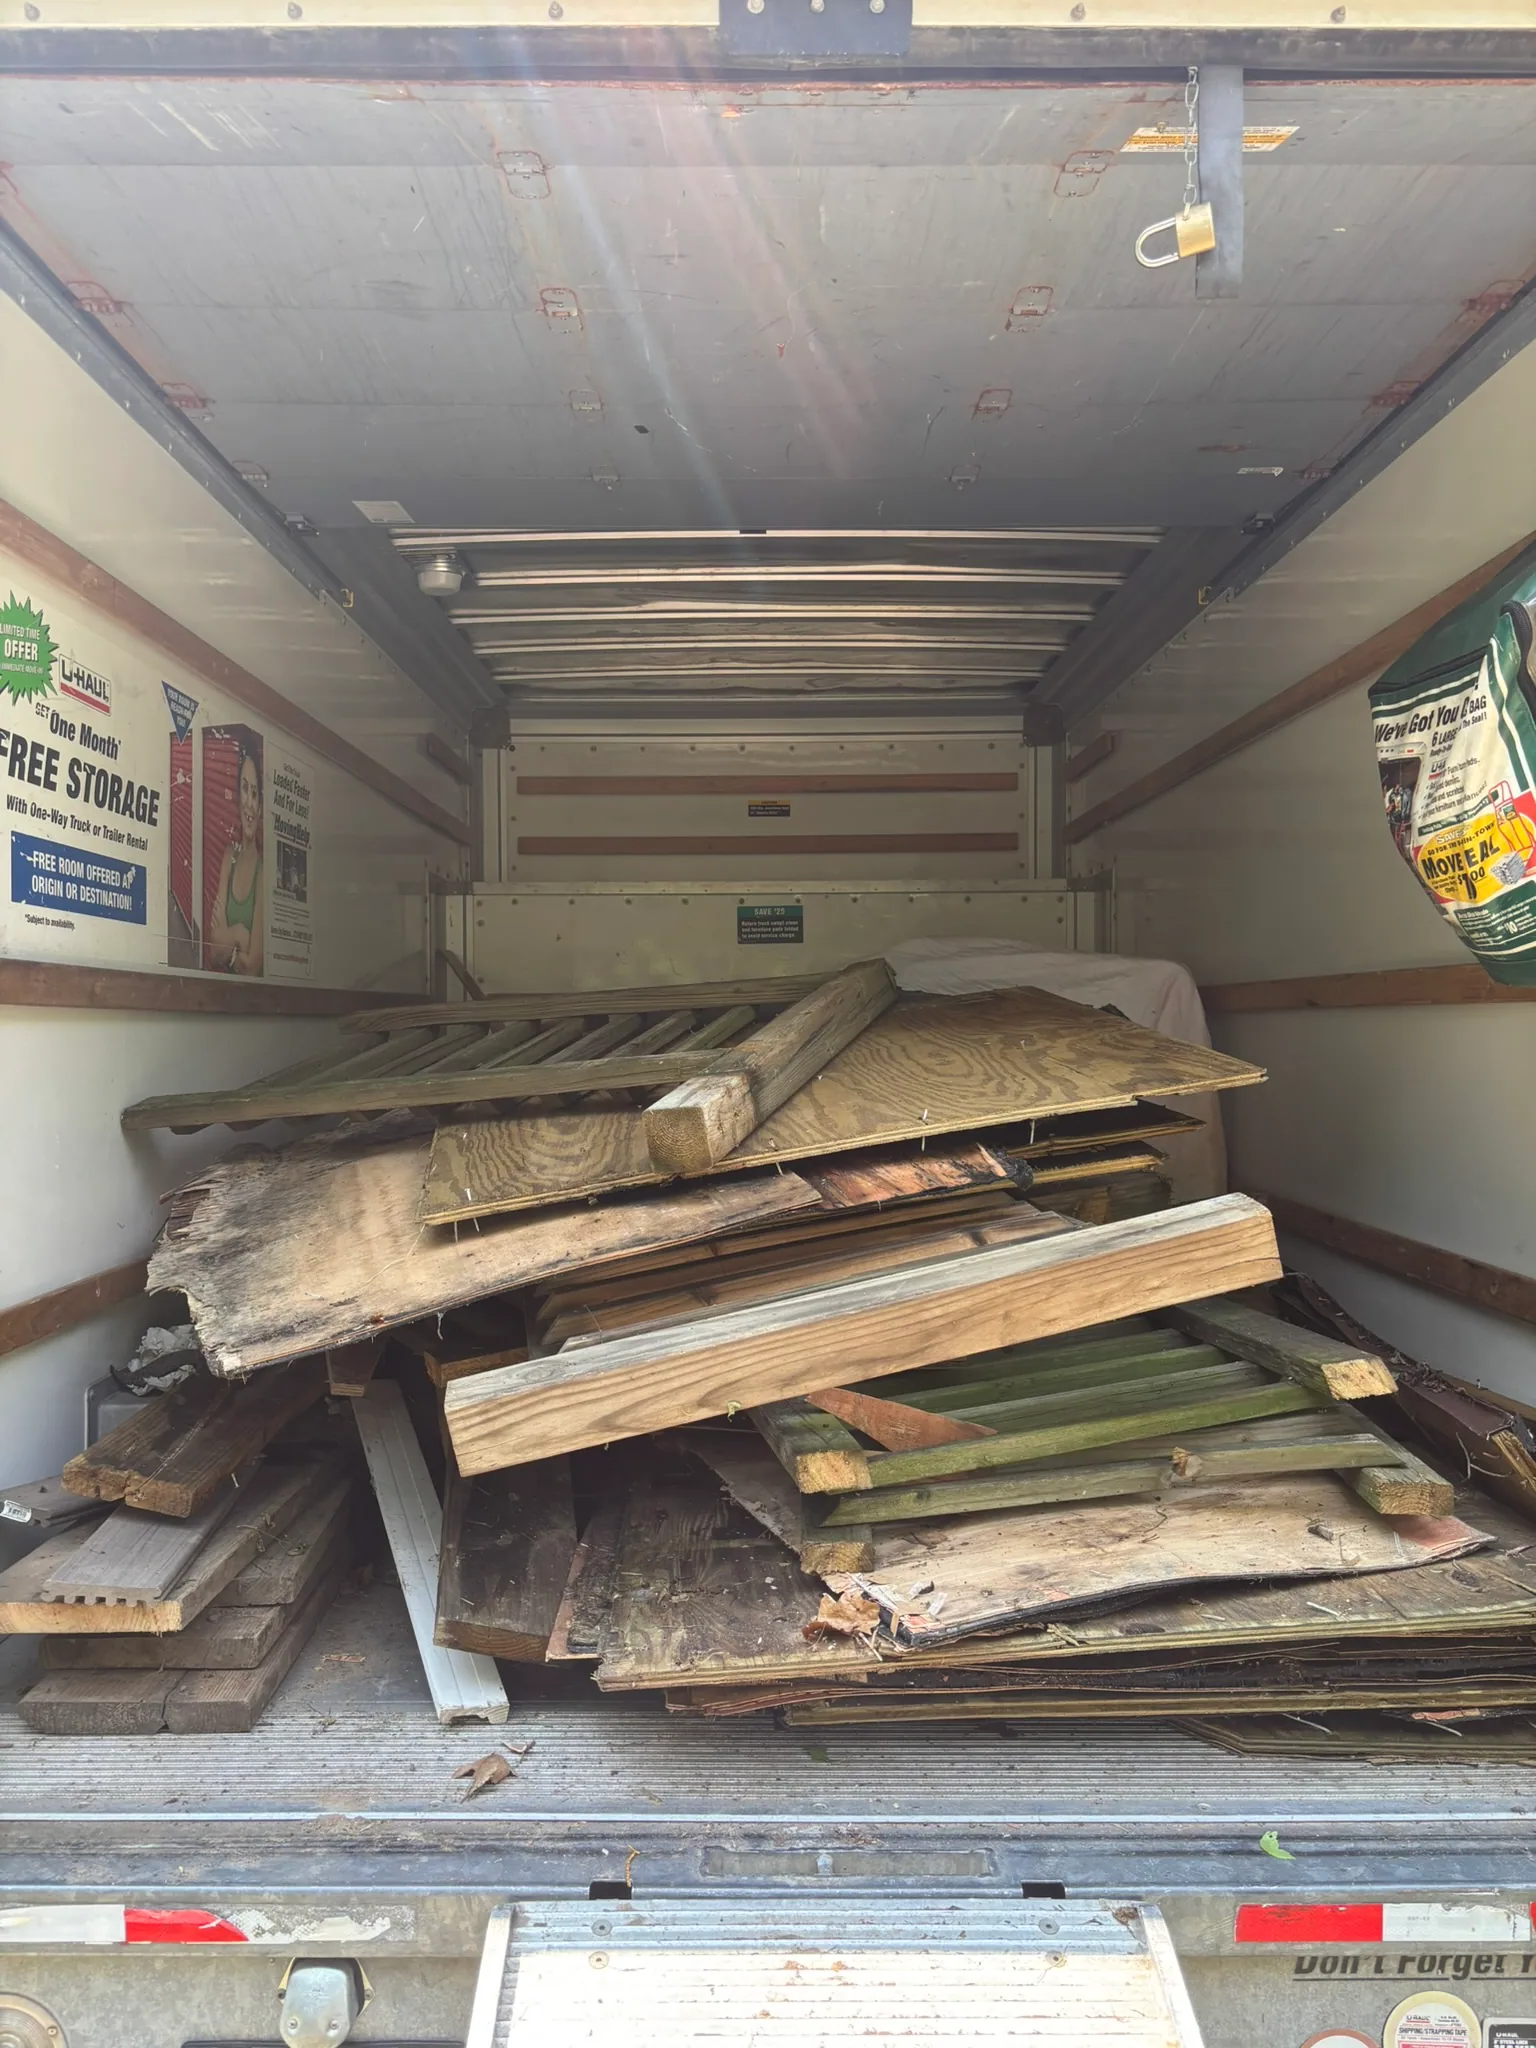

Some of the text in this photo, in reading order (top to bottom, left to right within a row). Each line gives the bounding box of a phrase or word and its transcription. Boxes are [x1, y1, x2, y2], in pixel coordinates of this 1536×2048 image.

[0, 623, 40, 640] LIMITED TIME
[4, 638, 39, 662] OFFER
[61, 659, 109, 702] U-HAUL
[35, 702, 50, 719] GET
[50, 711, 76, 742] One
[1374, 721, 1409, 743] We've
[1408, 710, 1435, 735] Got
[1436, 705, 1460, 727] You
[1469, 695, 1487, 714] BAG
[1431, 731, 1439, 748] 6
[66, 757, 160, 827] STORAGE
[273, 768, 293, 793] Loaded
[273, 789, 286, 809] And
[286, 795, 295, 813] For
[6, 794, 149, 851] With One-Way Truck or Trailer Rental
[32, 850, 57, 872] FREE
[58, 857, 85, 879] ROOM
[86, 864, 120, 887] OFFERED
[1421, 852, 1464, 880] MOVE
[31, 875, 133, 911] ORIGIN OR DESTINATION!
[45, 917, 50, 925] to
[754, 907, 772, 916] SAVE
[1294, 1954, 1386, 1974] Don't
[1397, 1953, 1509, 1981] Forget
